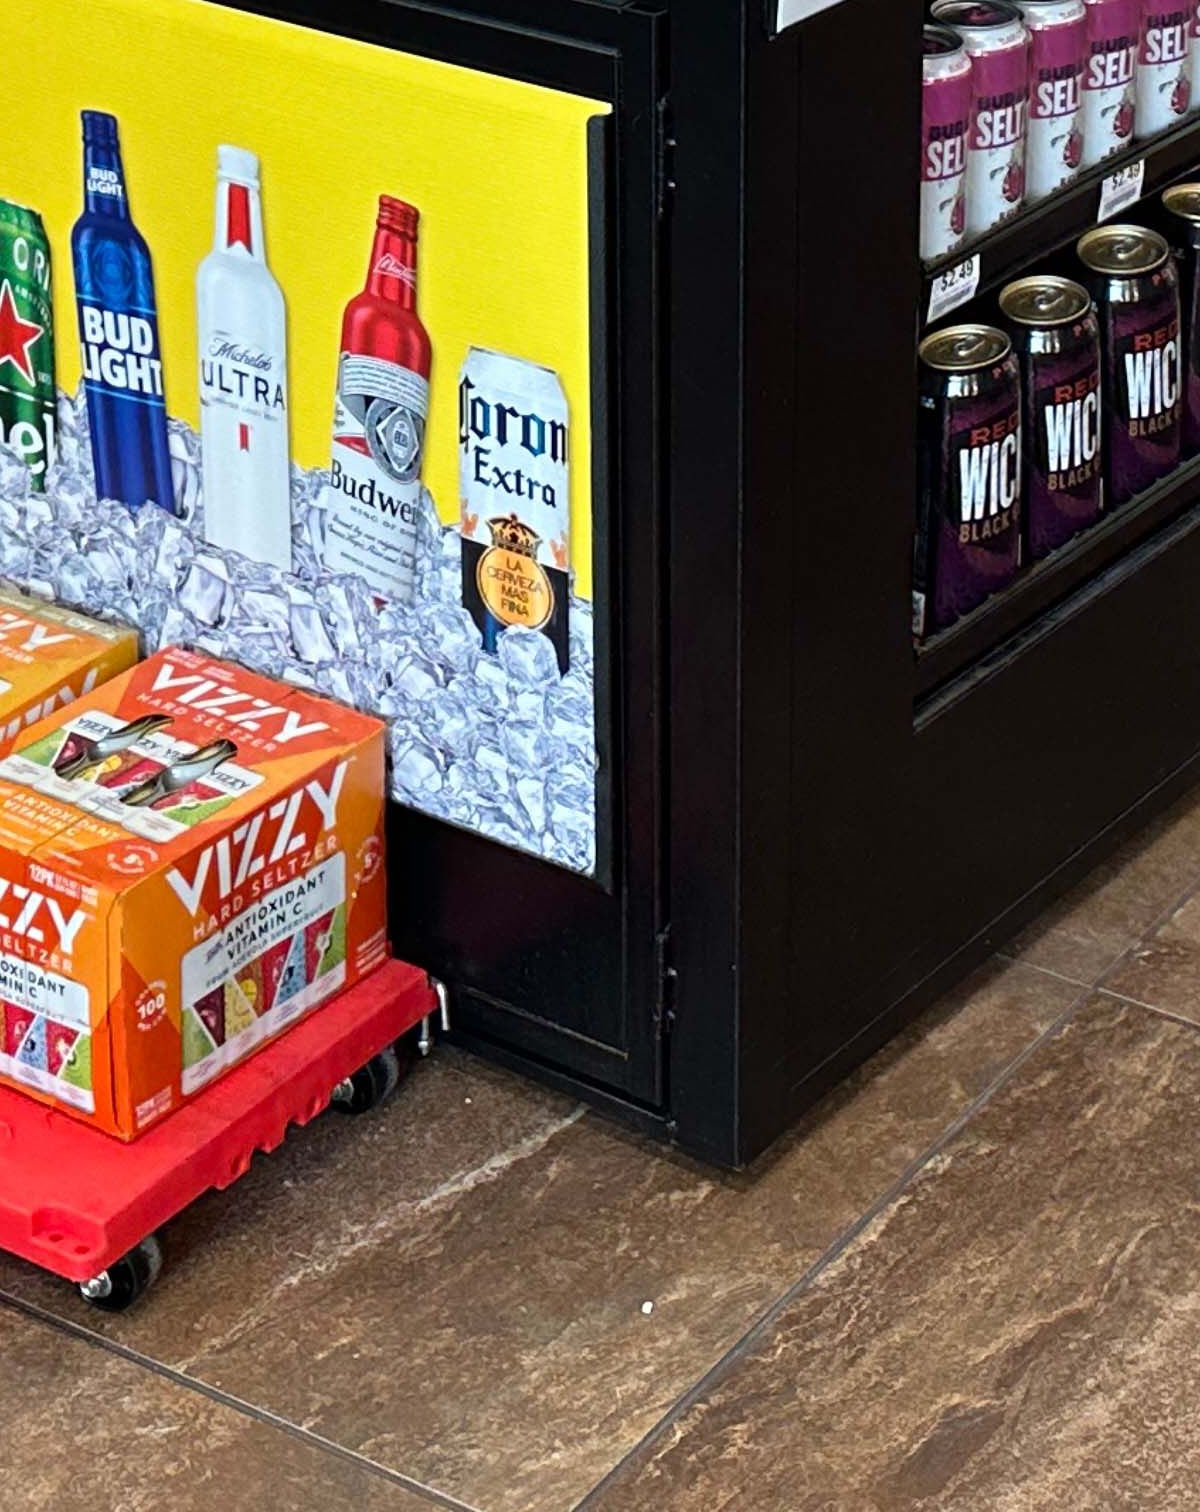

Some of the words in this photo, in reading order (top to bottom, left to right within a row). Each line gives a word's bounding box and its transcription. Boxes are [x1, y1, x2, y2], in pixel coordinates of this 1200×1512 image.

[90, 166, 119, 184] BUD
[82, 305, 155, 355] BUD
[80, 341, 164, 397] LIGHT
[202, 357, 286, 412] ULTRA
[1124, 332, 1182, 419] WIC
[1044, 384, 1101, 473] WIC
[474, 444, 557, 509] Extra
[959, 426, 1022, 522] WIC
[486, 565, 545, 595] CERVEZA
[500, 584, 529, 604] MAS
[506, 555, 524, 574] LA
[500, 597, 530, 618] FINA
[136, 692, 189, 716] HARD
[193, 713, 278, 753] SELTZER
[152, 663, 331, 744] VIZZY
[165, 758, 349, 917] VIZZY
[193, 895, 244, 942] HARD
[252, 835, 337, 898] SELTZER
[225, 871, 326, 946] ANTIOXIDANT
[227, 910, 286, 961] VITAMIN
[292, 902, 303, 916] C
[137, 992, 166, 1020] 100
